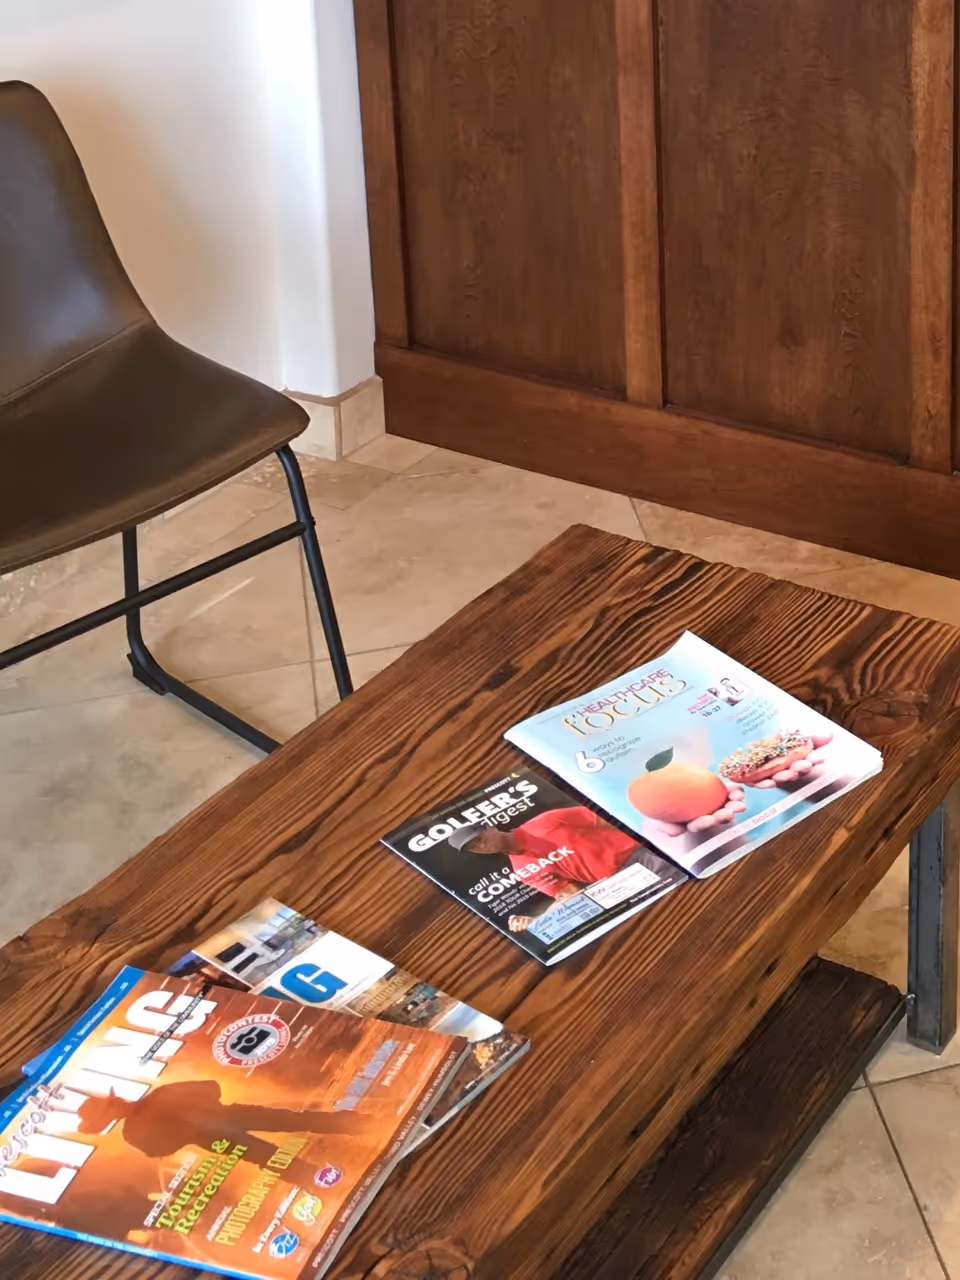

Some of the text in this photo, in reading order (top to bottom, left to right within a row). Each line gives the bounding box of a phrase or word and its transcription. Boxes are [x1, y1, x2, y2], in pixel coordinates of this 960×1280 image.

[577, 669, 668, 717] HEALTHCARE
[484, 776, 511, 793] PRESCOTT
[576, 751, 606, 773] 6
[408, 780, 538, 852] GOLFER'S
[469, 867, 510, 895] call it a
[477, 845, 575, 903] COMEBACK
[225, 1016, 275, 1035] CONTEST
[155, 1138, 232, 1229] Tourism &
[175, 1144, 248, 1235] Recreation
[216, 1166, 281, 1245] PHOTOGRAPHY
[312, 1229, 339, 1267] PRESCOTT
[340, 1186, 365, 1222] PRESCOTT
[397, 1116, 417, 1140] VALLEY
[259, 1218, 281, 1242] Every
